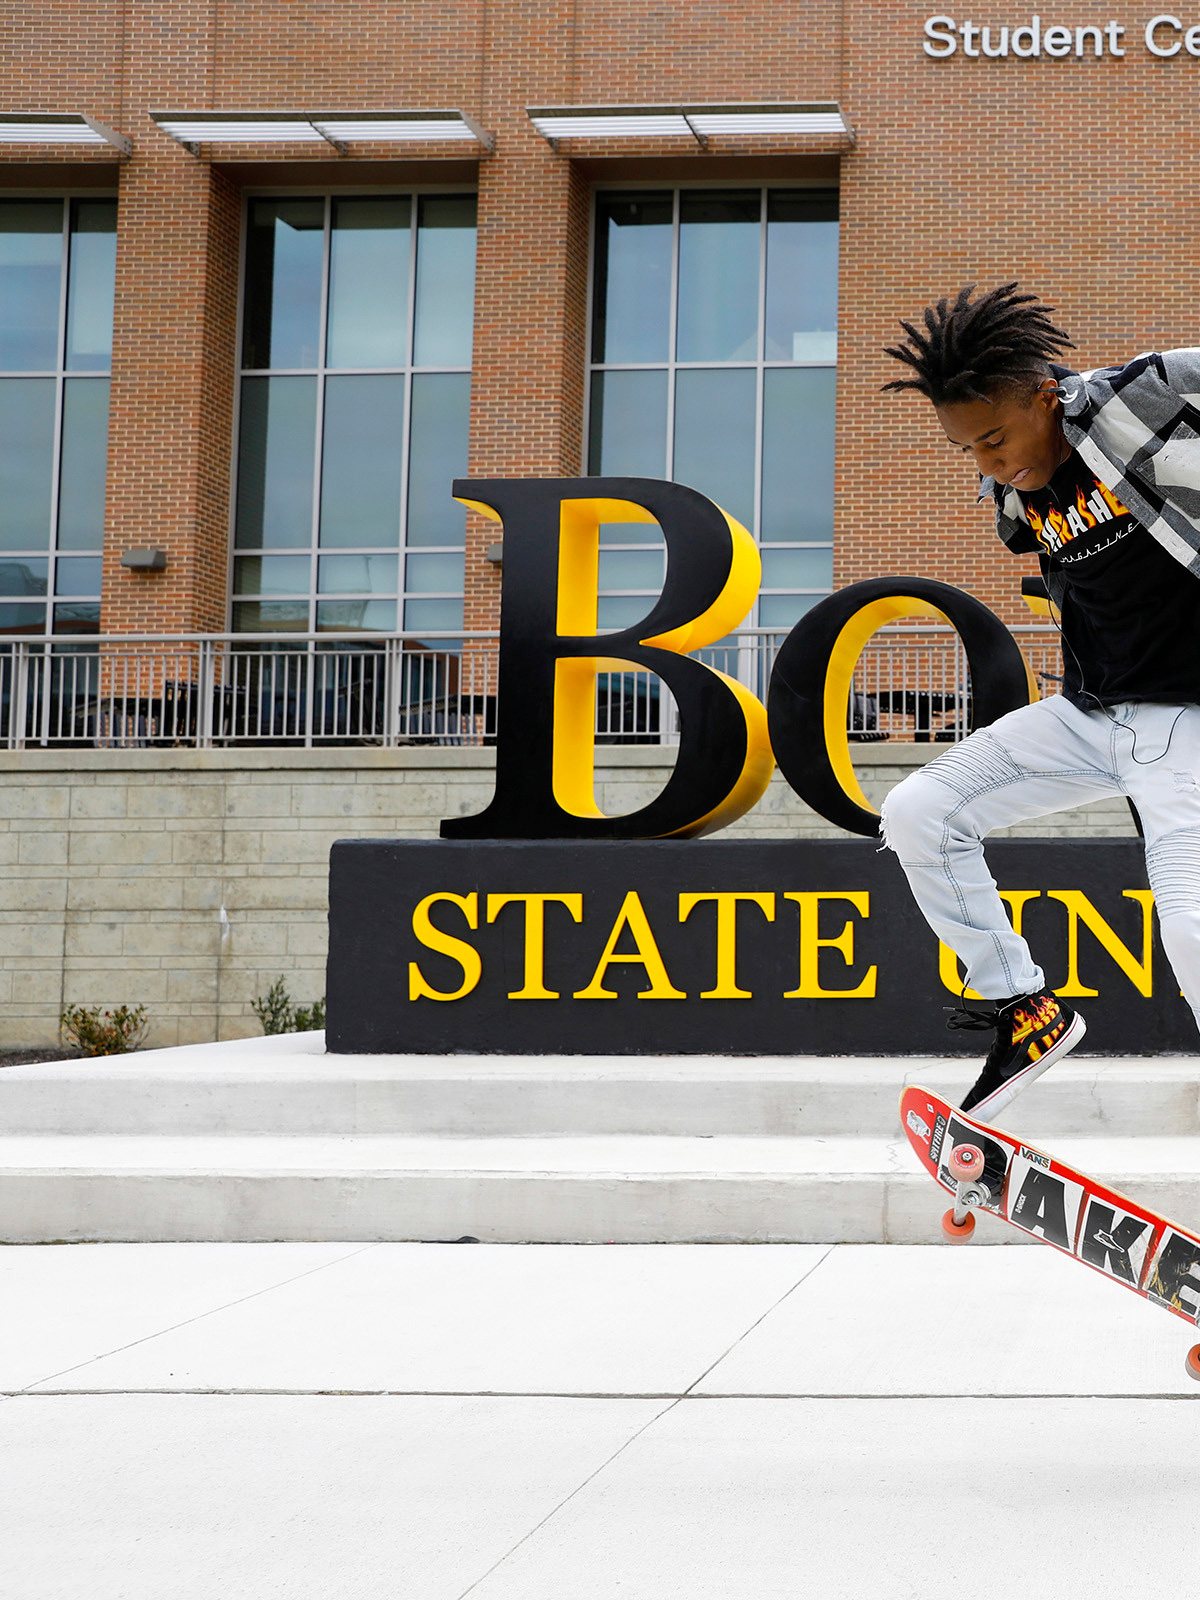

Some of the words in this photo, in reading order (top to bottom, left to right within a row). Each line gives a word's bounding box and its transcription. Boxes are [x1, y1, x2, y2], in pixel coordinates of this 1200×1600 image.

[922, 15, 1126, 58] Student
[1025, 480, 1131, 556] THRASHE
[407, 890, 879, 1002] STATE
[1021, 1146, 1050, 1169] VANS
